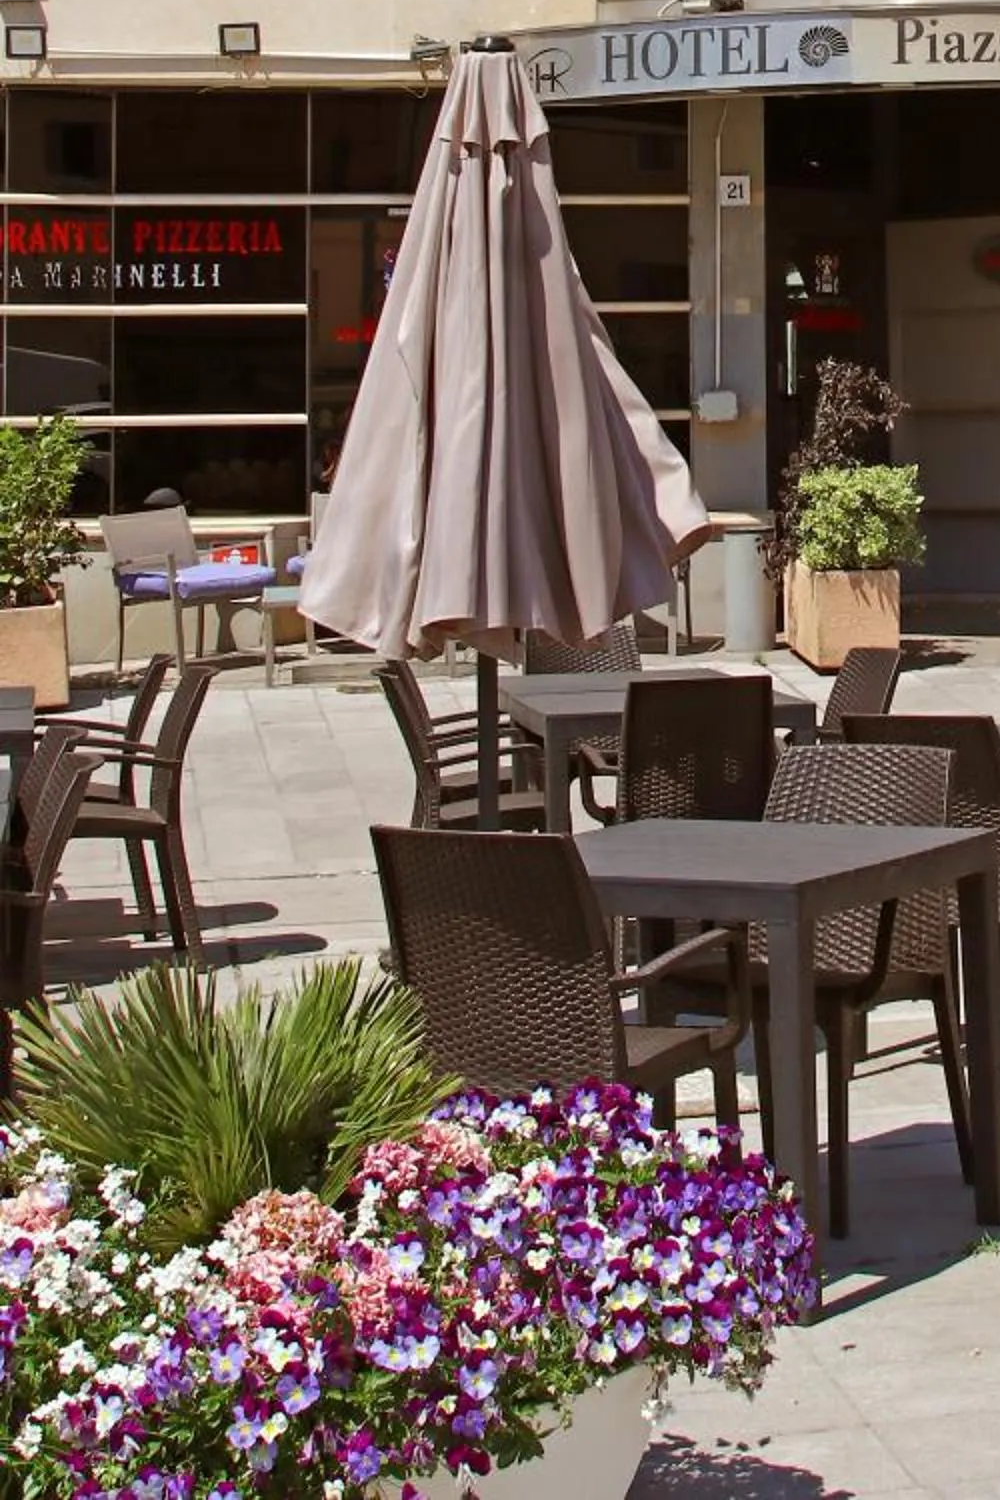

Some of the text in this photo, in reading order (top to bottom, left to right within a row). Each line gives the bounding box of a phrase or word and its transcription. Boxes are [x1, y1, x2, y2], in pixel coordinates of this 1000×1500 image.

[600, 25, 789, 84] HOTEL
[726, 181, 745, 200] 21
[0, 219, 283, 256] RANTE PIZZERIA
[43, 262, 222, 289] MARINELLI
